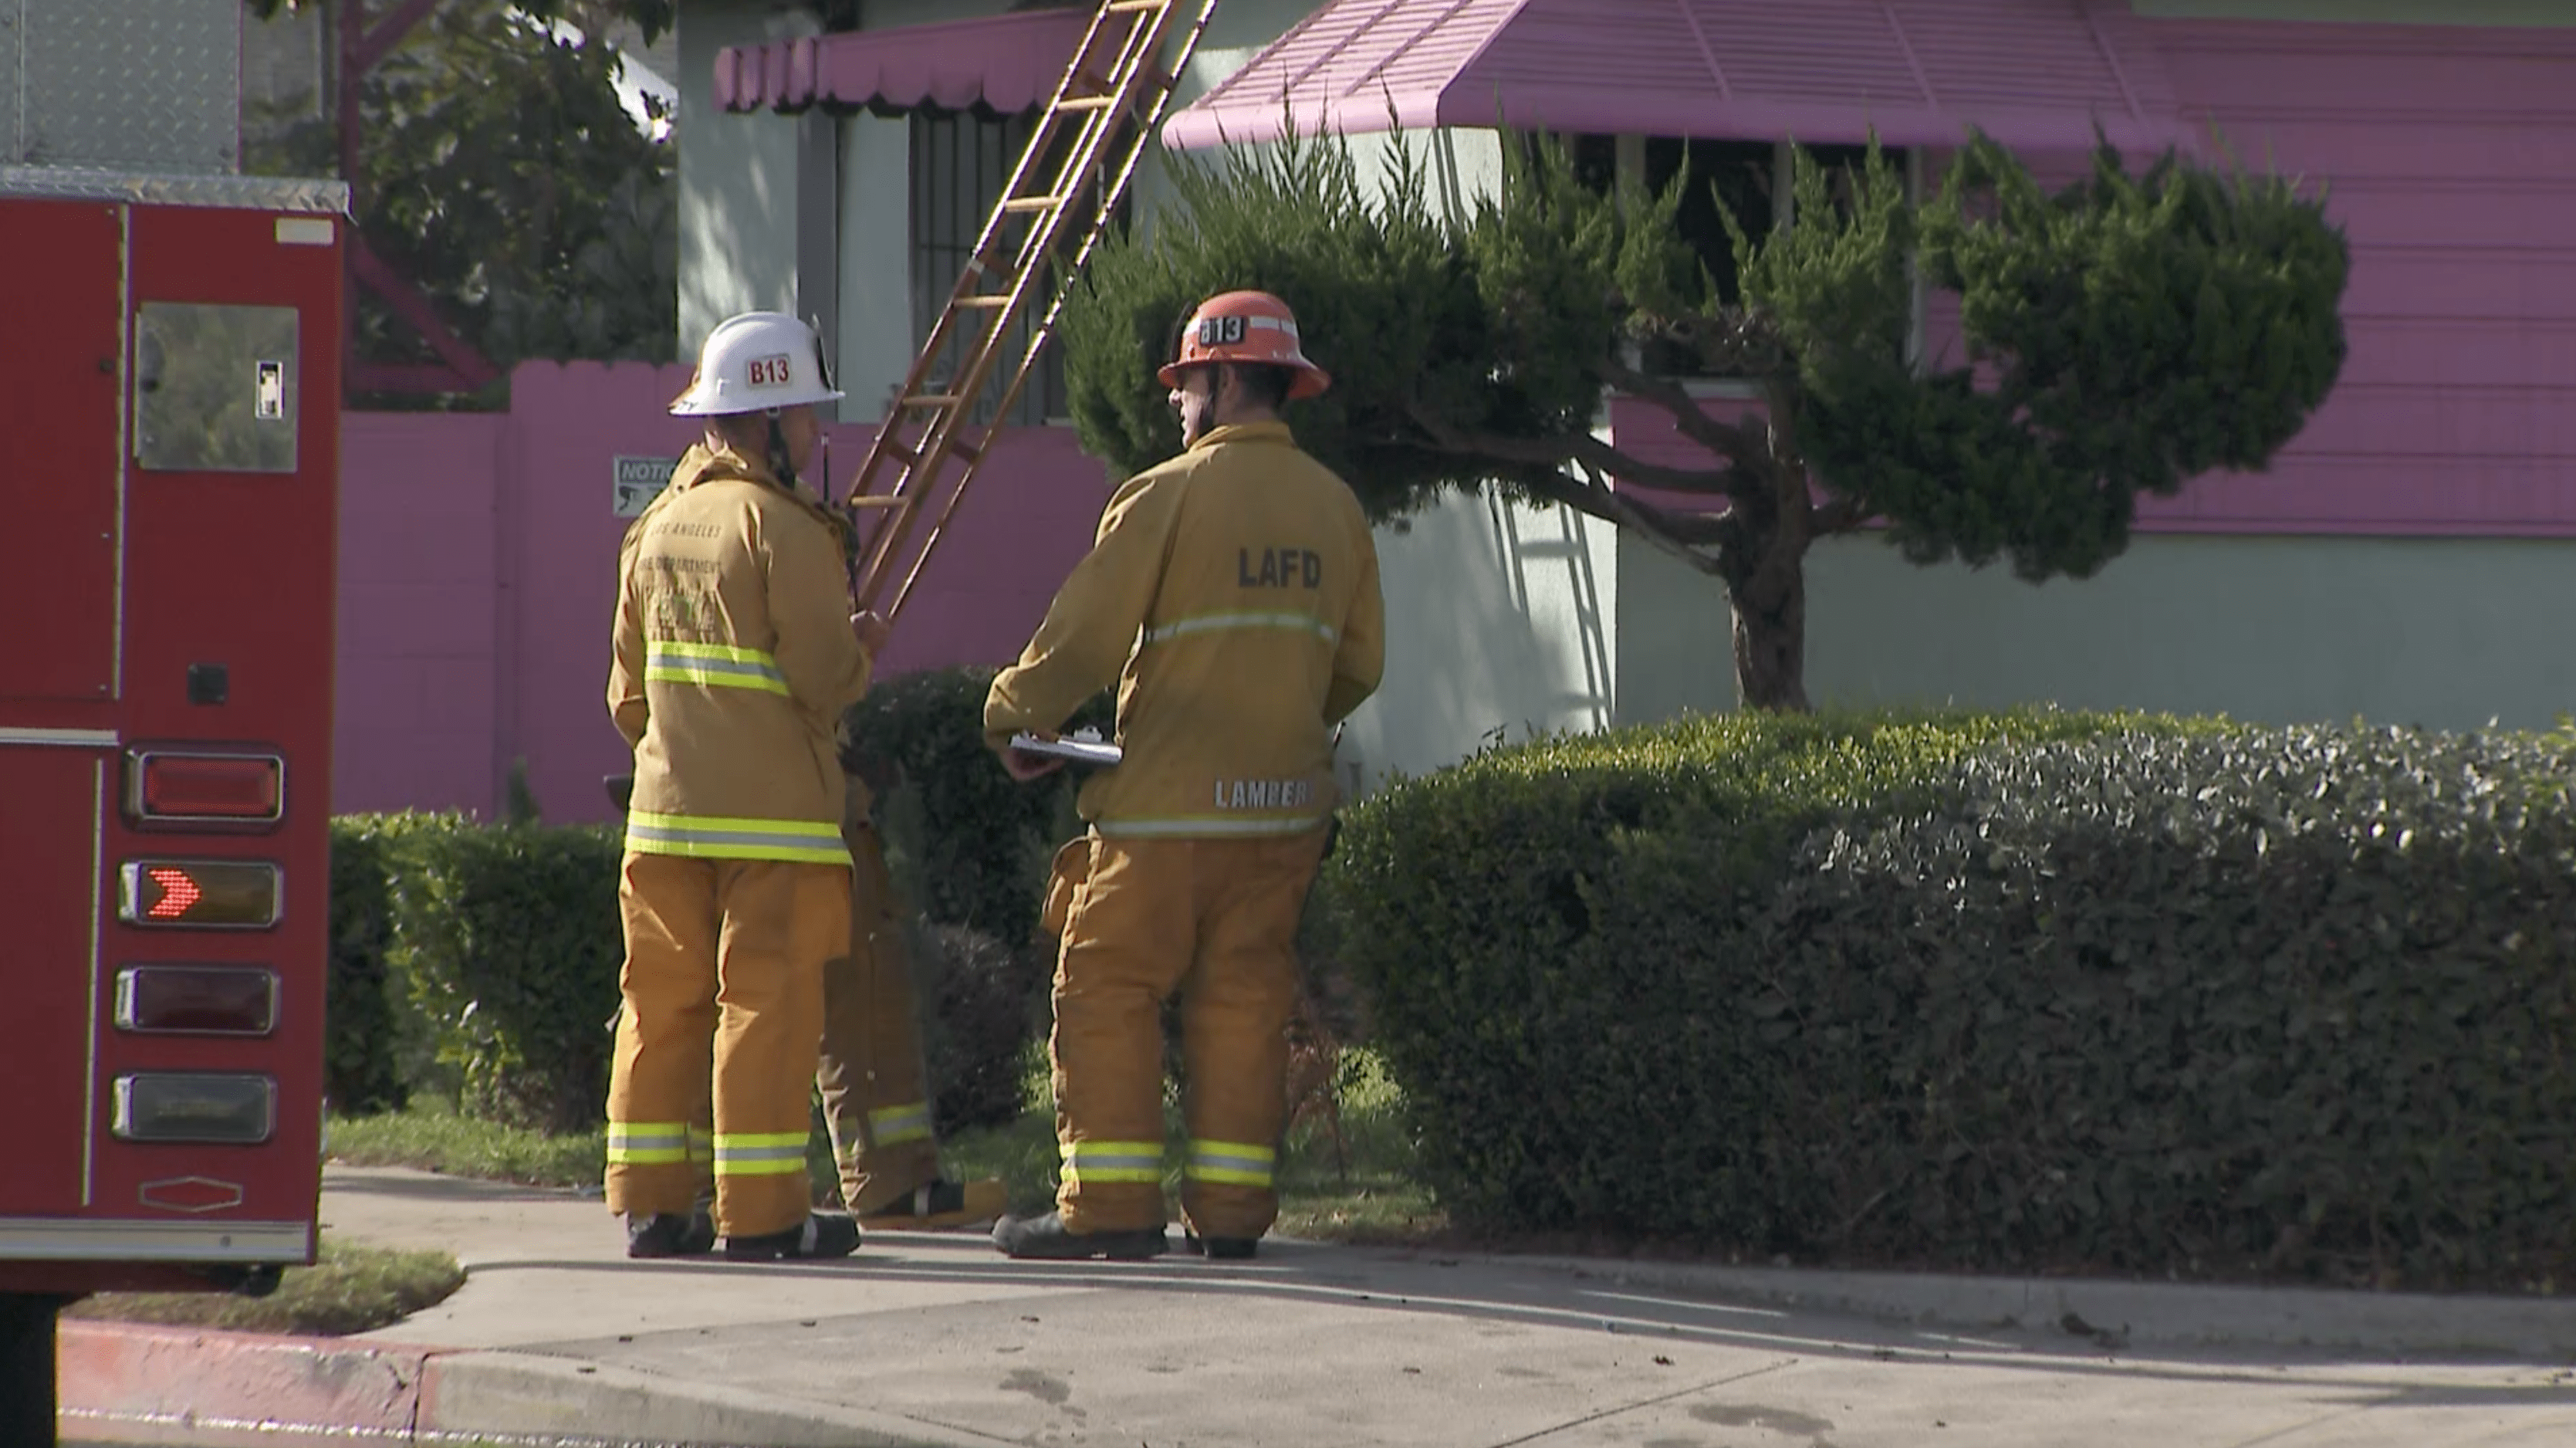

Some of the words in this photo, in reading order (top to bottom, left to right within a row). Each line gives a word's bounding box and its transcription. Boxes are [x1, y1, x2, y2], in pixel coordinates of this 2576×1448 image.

[1200, 316, 1242, 343] B13
[750, 358, 789, 384] B13
[621, 463, 677, 480] NOTIC
[1239, 546, 1322, 589] LAFD
[1215, 779, 1311, 809] LAMBER
